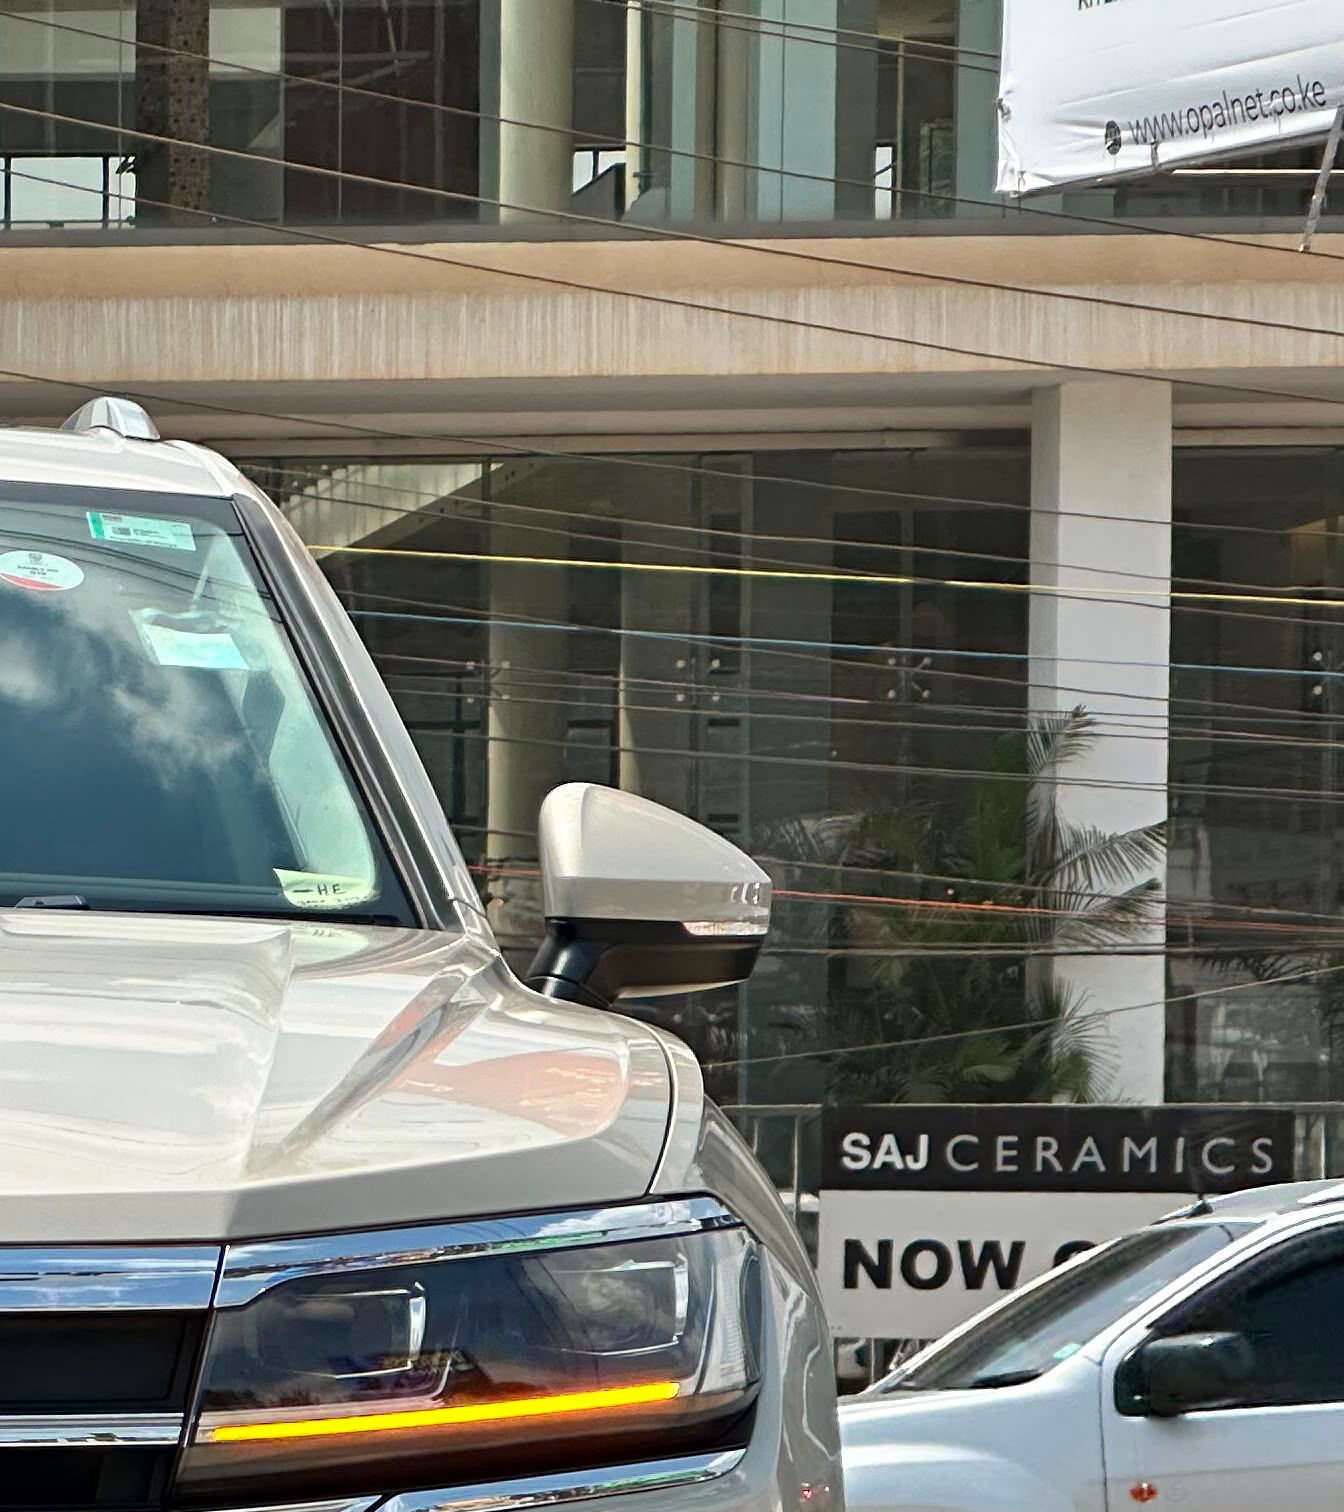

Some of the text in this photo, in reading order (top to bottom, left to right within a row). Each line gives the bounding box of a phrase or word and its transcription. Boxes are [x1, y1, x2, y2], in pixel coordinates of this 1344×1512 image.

[1128, 75, 1327, 144] www.opalnet.co.ke
[841, 1132, 1275, 1175] SAJ CERAMICS
[843, 1238, 1026, 1291] NOW
